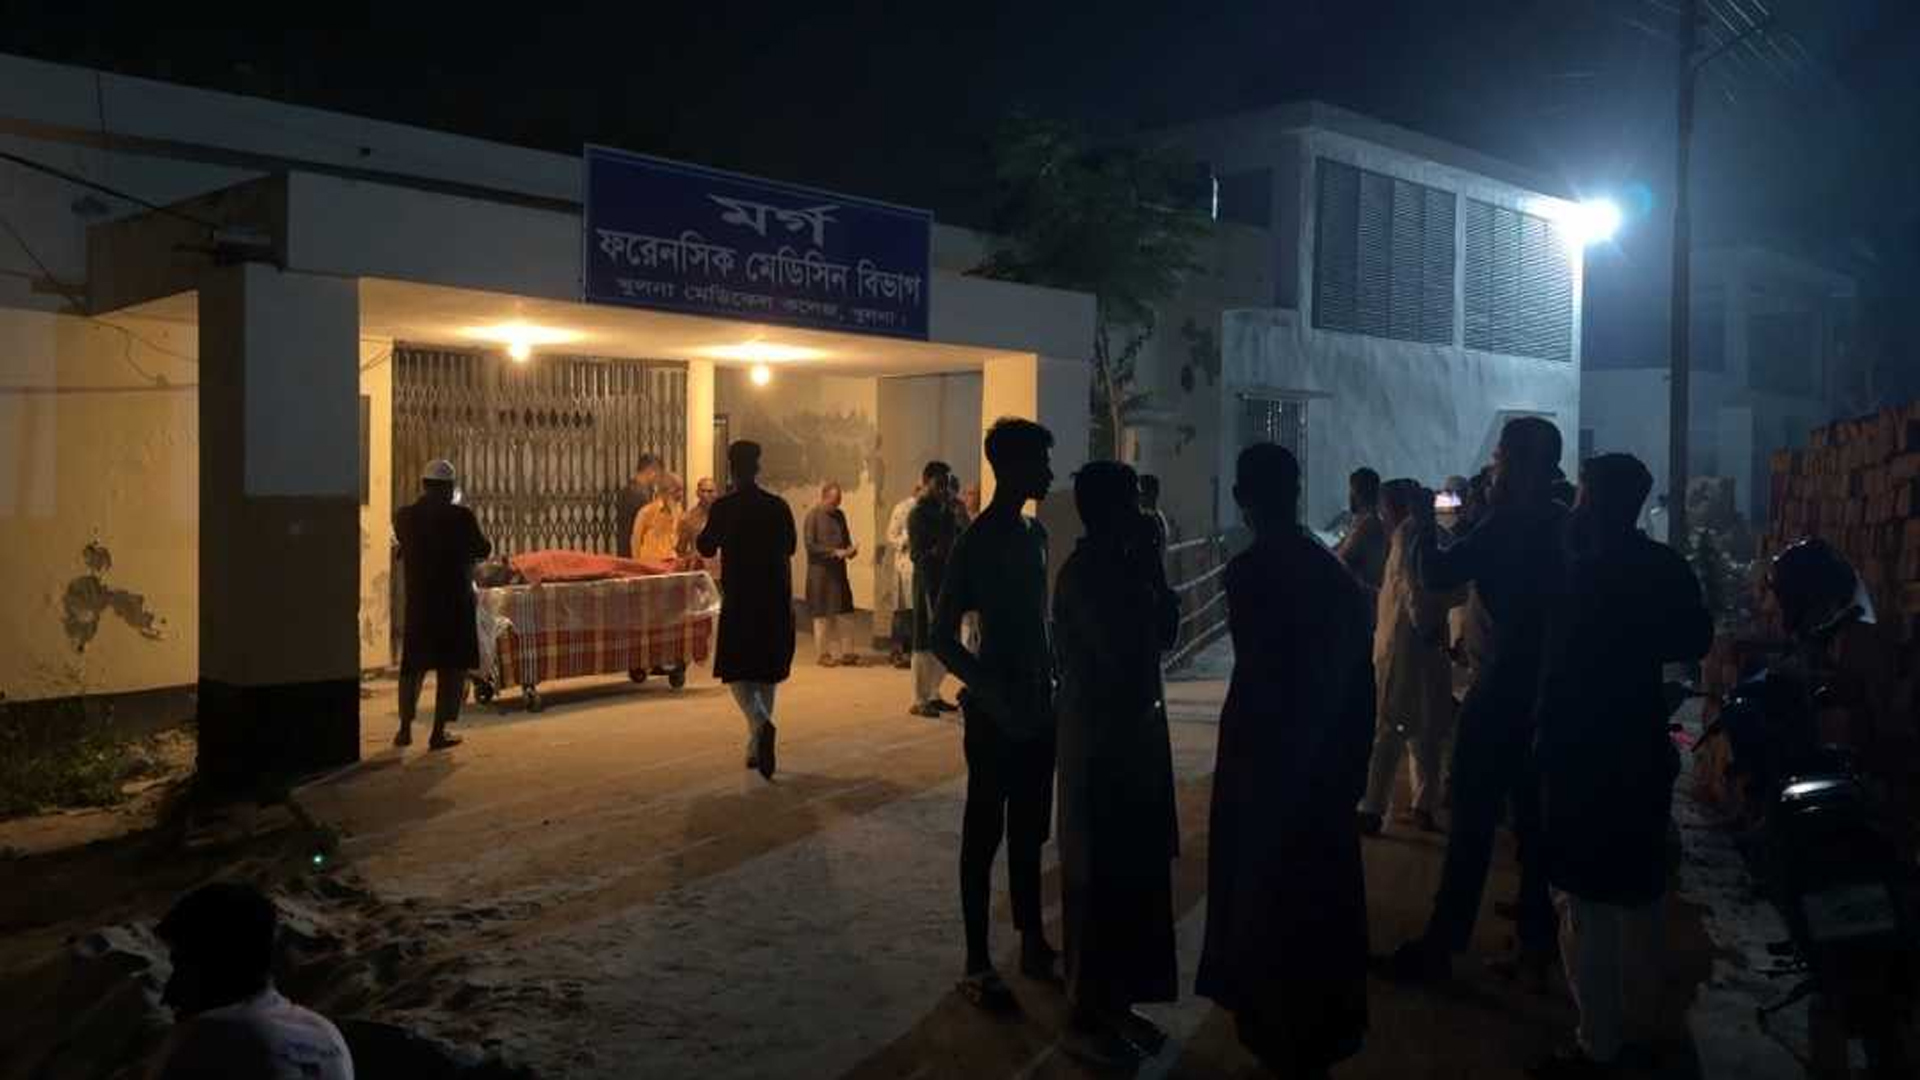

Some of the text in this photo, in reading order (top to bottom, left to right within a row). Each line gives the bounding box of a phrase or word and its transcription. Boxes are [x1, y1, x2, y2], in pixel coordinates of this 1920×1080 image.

[707, 193, 841, 248] মর্গ
[597, 229, 921, 306] ফরেনসিক মেডিসিন বিভাগ
